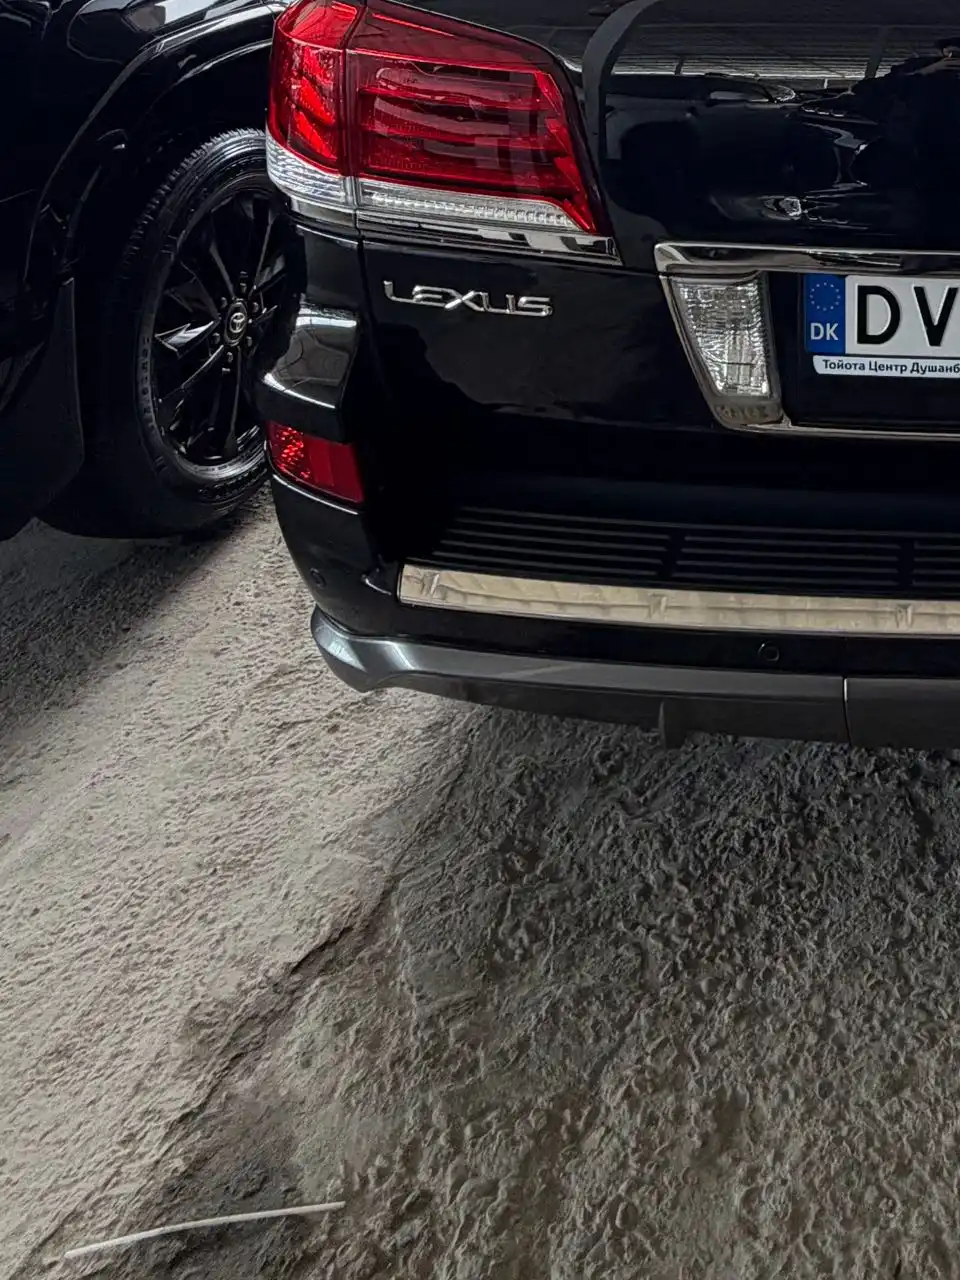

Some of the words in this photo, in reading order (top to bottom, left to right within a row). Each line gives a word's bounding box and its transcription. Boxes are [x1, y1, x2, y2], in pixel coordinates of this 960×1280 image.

[383, 280, 553, 317] LEXUS
[855, 284, 959, 348] DV
[810, 321, 839, 342] DK
[822, 358, 866, 371] Тойота
[868, 360, 908, 374] Центр
